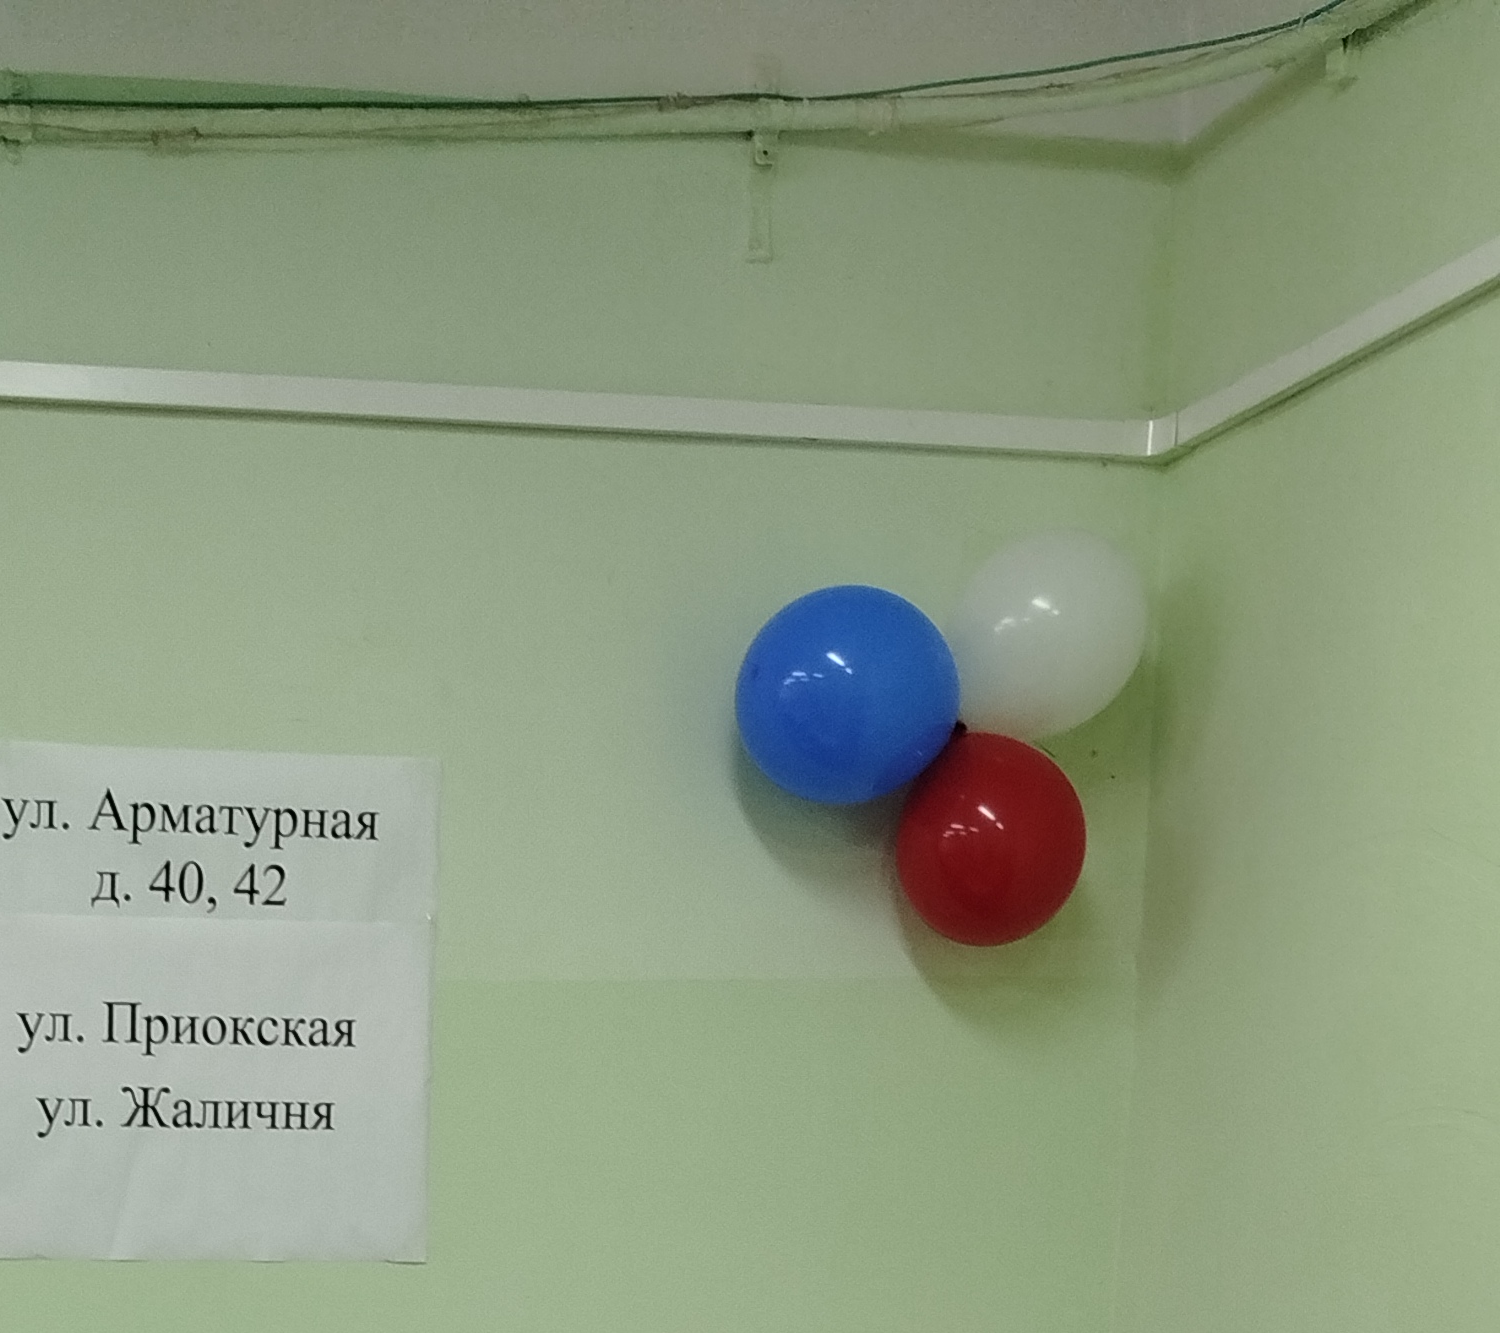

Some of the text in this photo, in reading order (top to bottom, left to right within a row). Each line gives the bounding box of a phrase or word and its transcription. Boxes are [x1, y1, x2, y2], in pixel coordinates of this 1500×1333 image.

[0, 786, 381, 851] ул. Арматурная
[89, 859, 288, 914] д. 40, 42
[15, 1000, 357, 1057] ул. Приокская
[35, 1084, 336, 1139] ул. Жаличня
